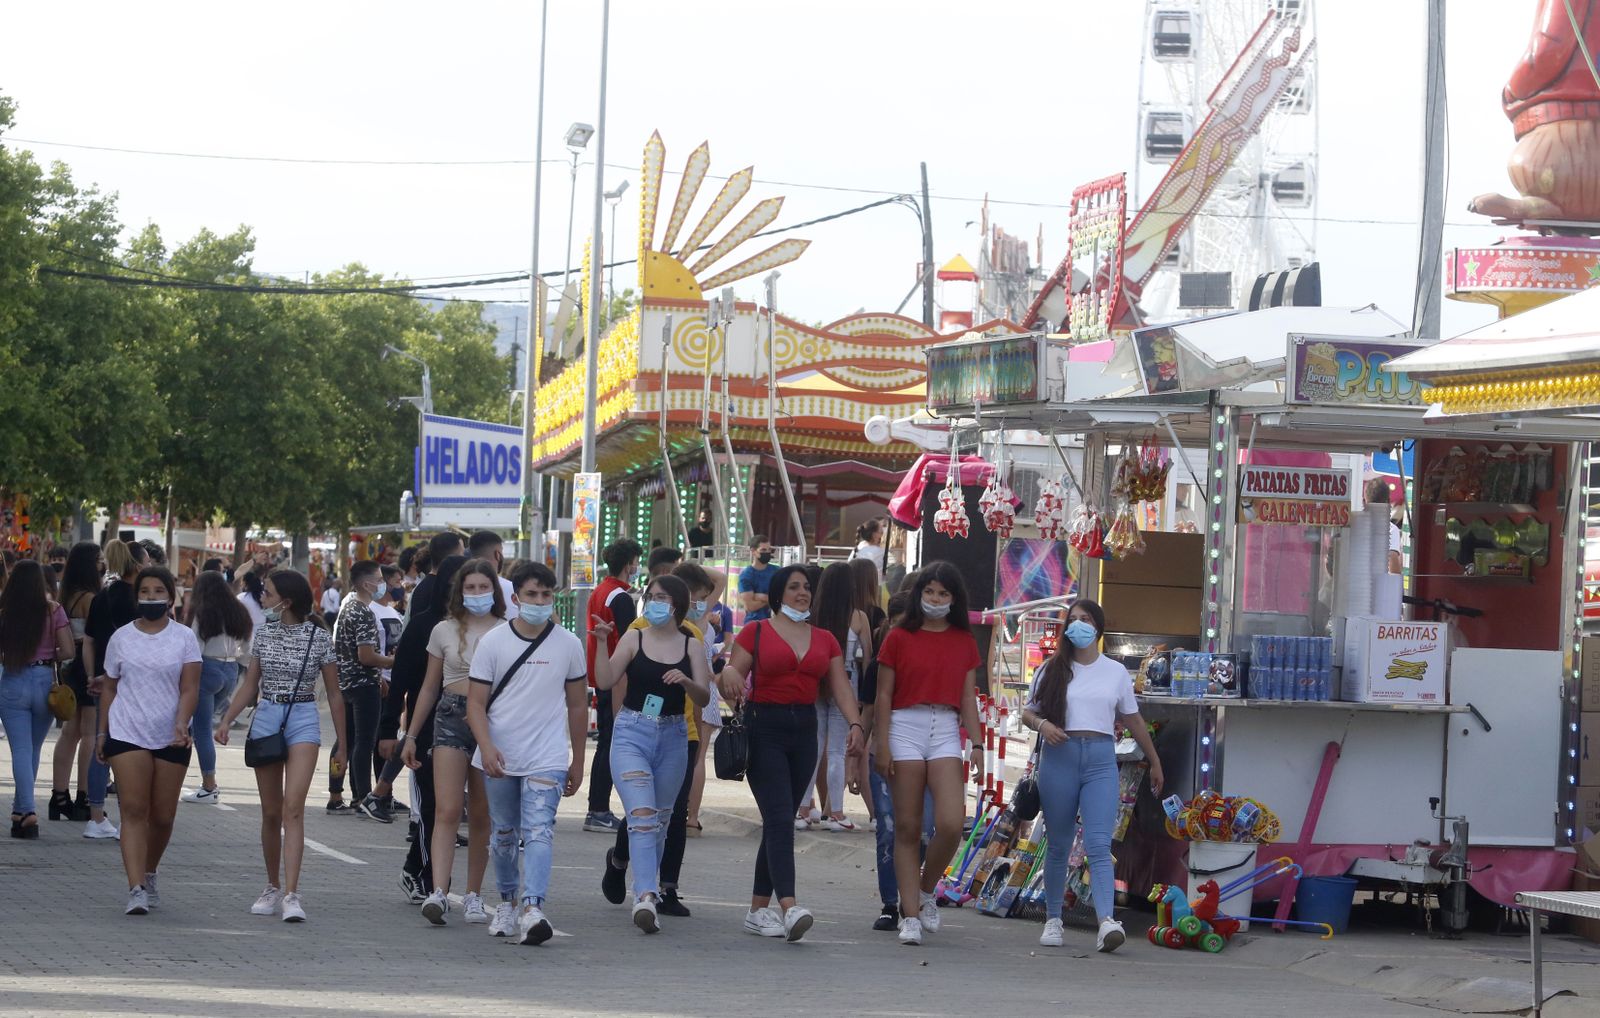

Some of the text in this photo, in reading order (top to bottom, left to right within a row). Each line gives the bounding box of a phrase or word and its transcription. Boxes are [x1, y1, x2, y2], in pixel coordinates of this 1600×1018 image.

[425, 435, 521, 485] HELADOS
[1246, 471, 1347, 496] PATATAS FRITAS
[1260, 501, 1349, 527] CALENTITAS
[1377, 625, 1438, 641] BARRITAS
